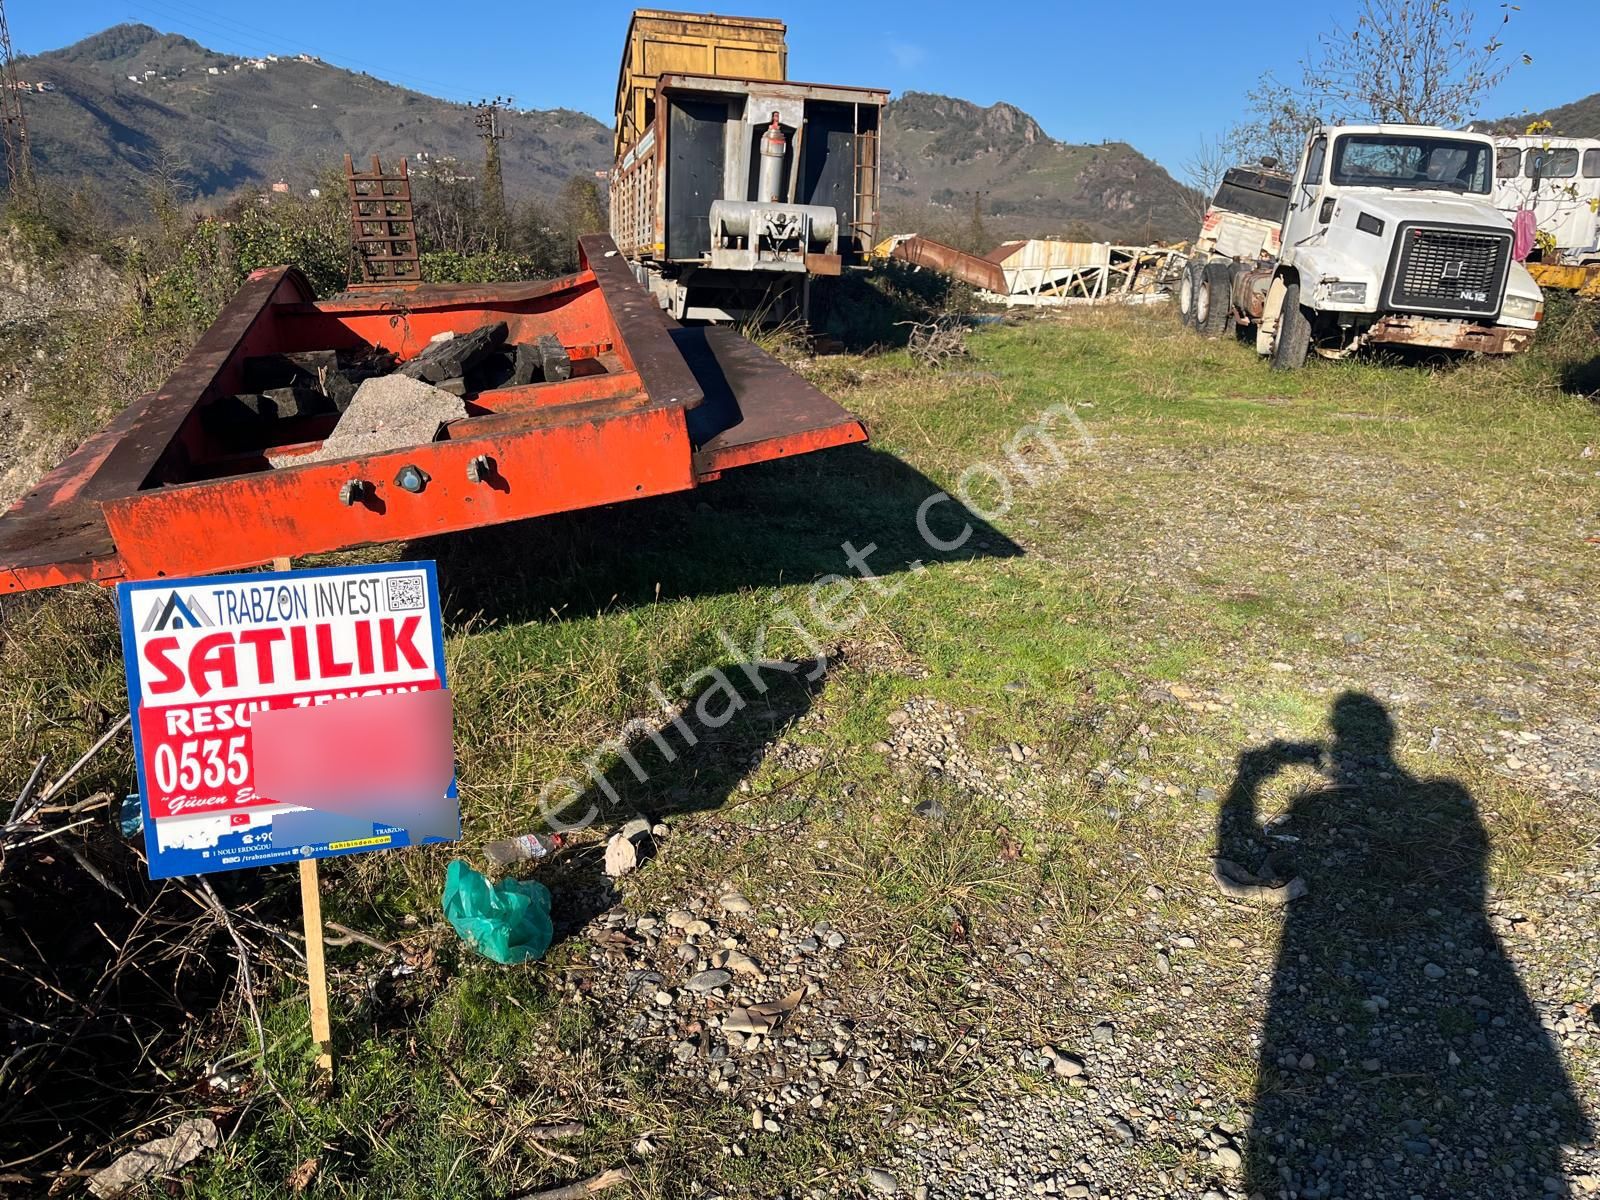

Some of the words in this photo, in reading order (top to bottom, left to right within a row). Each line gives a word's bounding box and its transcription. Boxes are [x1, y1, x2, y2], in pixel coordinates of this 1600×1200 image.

[212, 585, 308, 626] TRABZON
[315, 578, 380, 618] INVEST
[143, 615, 429, 698] SATILIK
[154, 734, 249, 794] 0535
